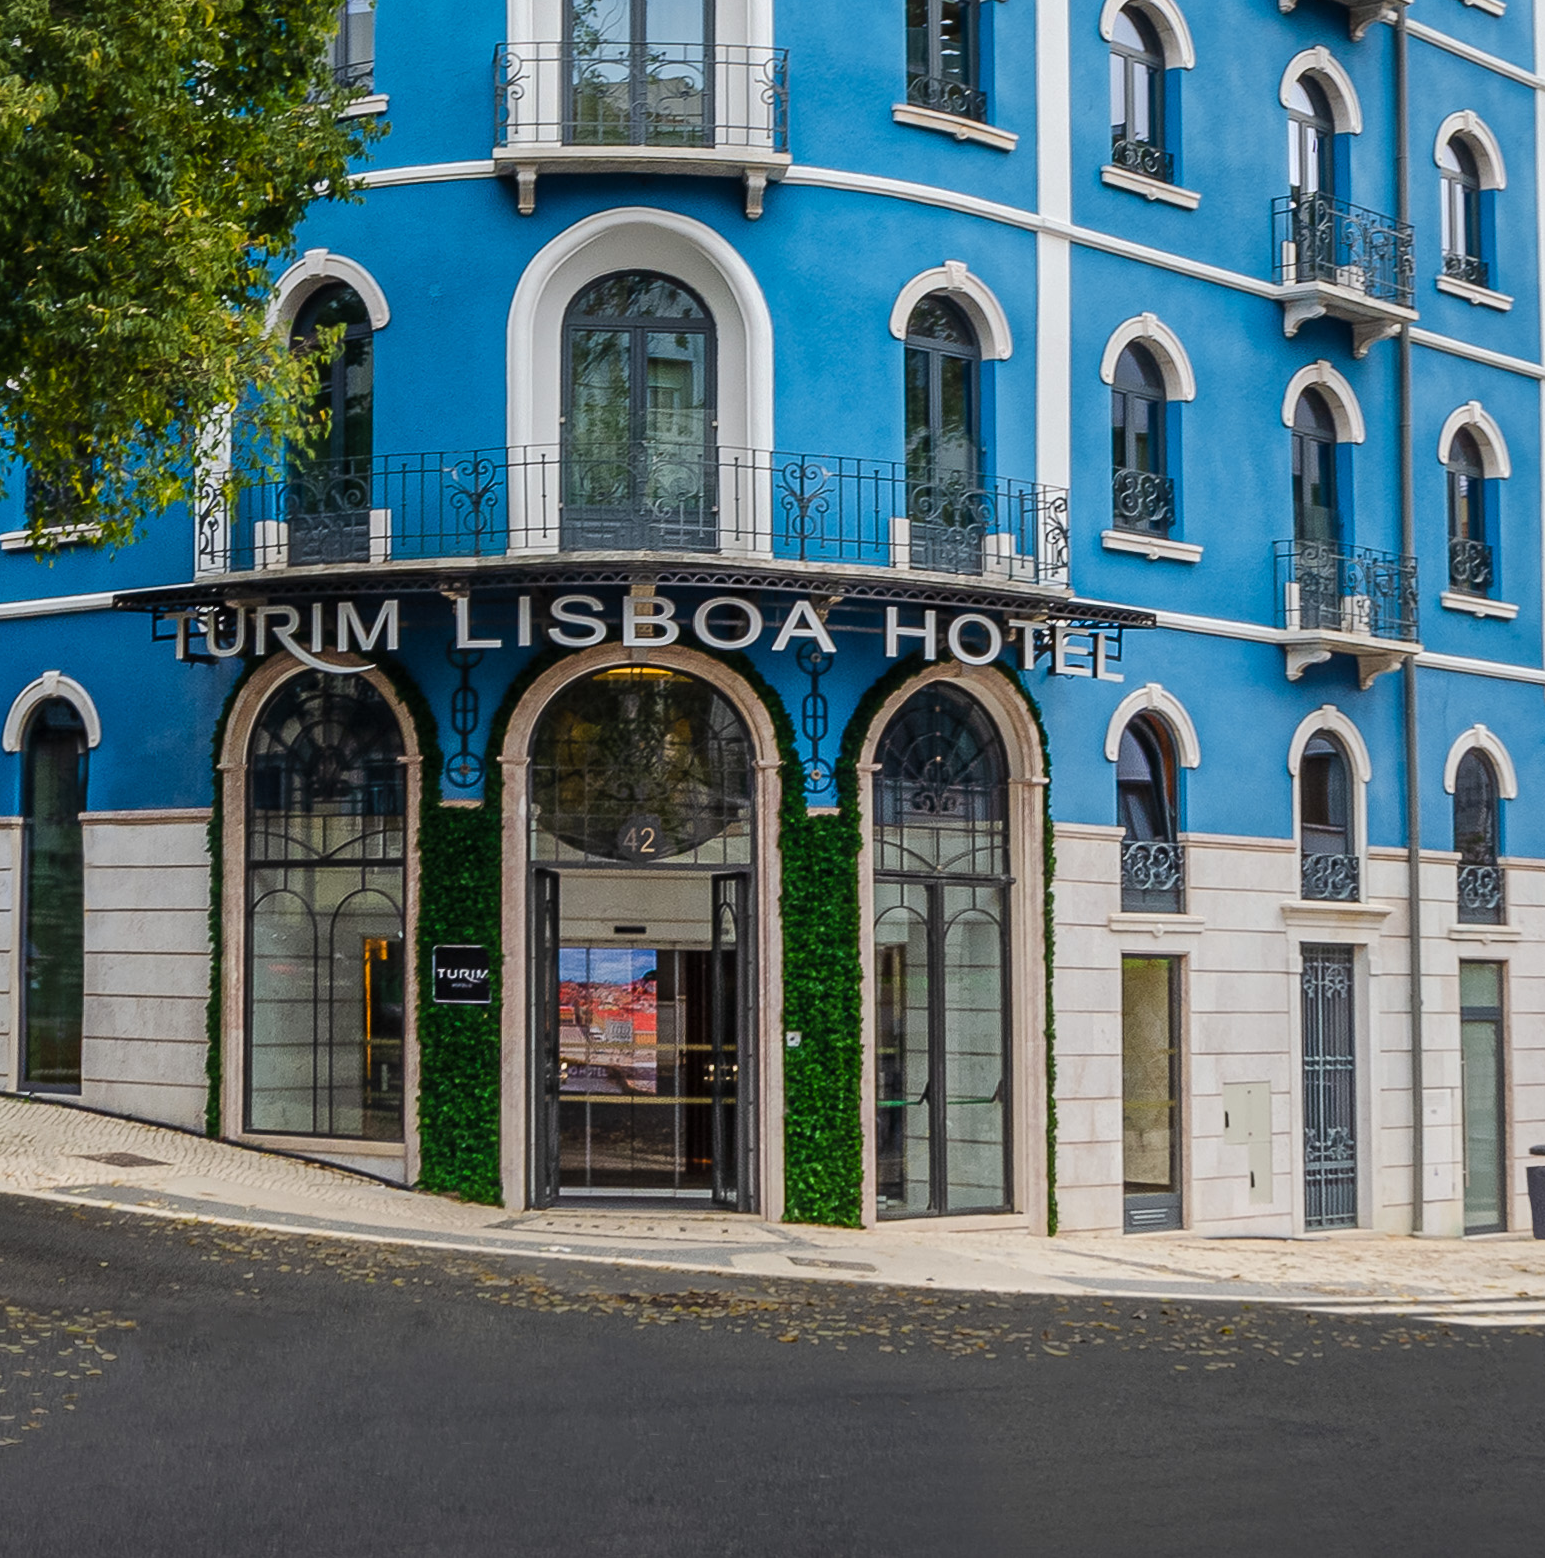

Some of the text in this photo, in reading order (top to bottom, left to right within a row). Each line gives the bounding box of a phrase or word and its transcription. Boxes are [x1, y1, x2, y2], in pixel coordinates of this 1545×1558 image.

[164, 594, 1126, 684] TURIM LISBOA HOTEL
[622, 827, 656, 853] 42
[436, 967, 490, 984] TURIM
